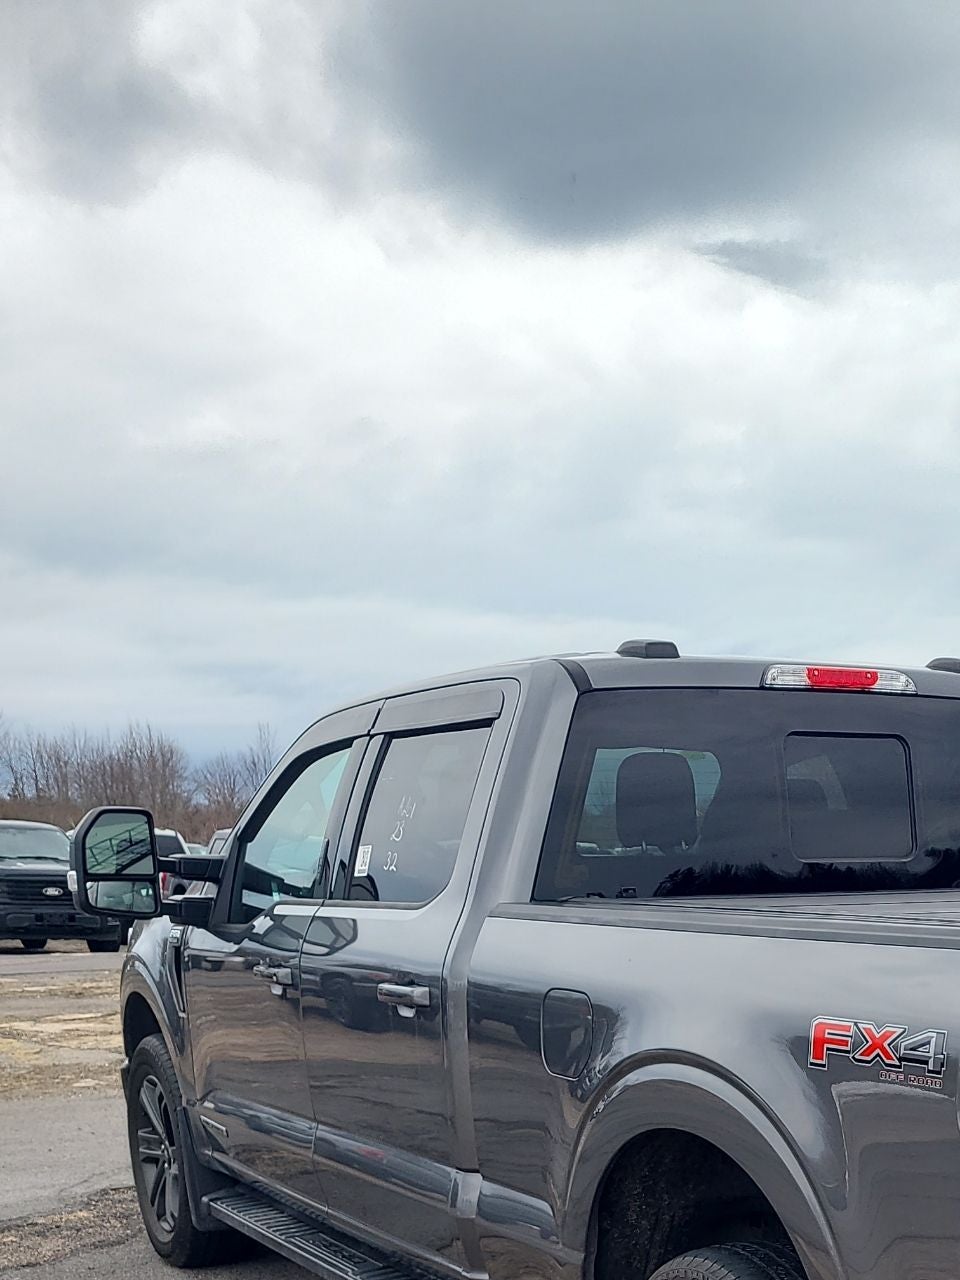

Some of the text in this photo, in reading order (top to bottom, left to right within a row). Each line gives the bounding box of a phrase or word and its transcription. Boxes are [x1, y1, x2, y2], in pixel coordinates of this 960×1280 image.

[383, 851, 398, 872] 32
[808, 1015, 948, 1078] FX4
[879, 1070, 943, 1089] OFF ROAD
